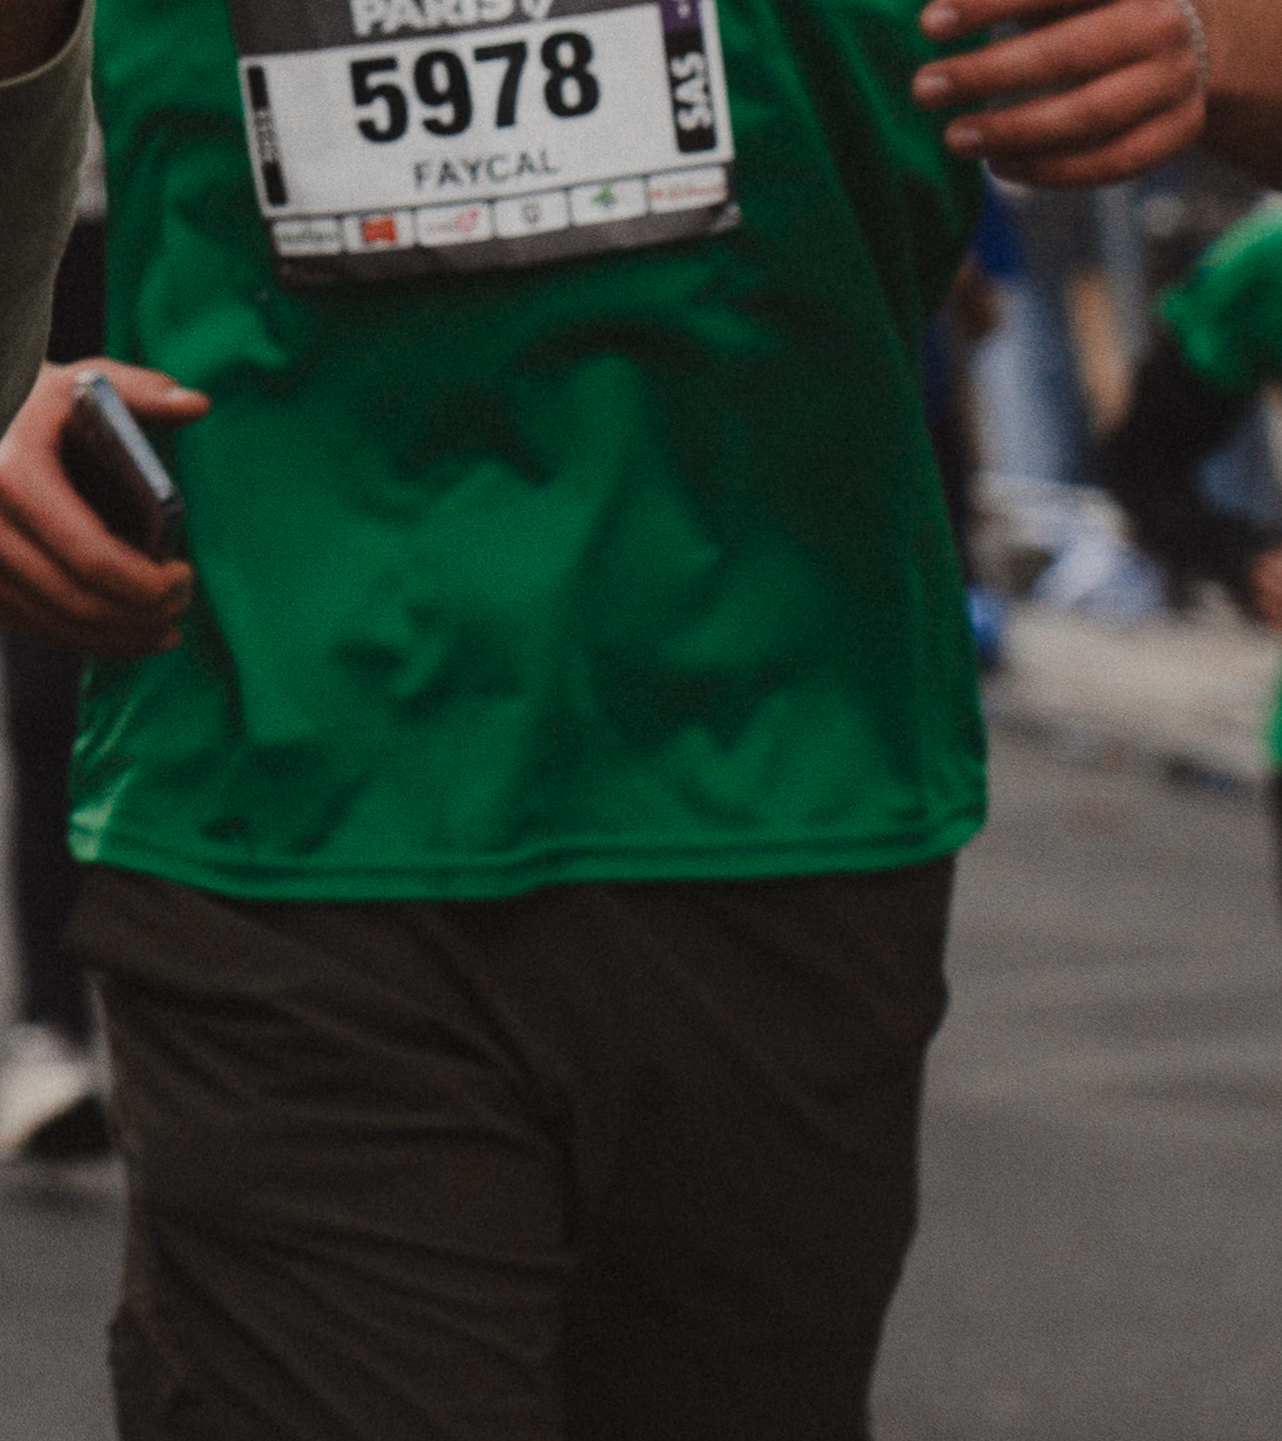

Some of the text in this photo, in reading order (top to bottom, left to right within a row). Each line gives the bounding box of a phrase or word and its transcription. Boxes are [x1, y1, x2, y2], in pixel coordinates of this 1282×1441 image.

[348, 31, 602, 144] 5978
[671, 51, 713, 134] SAS
[414, 150, 562, 191] FAYCAL
